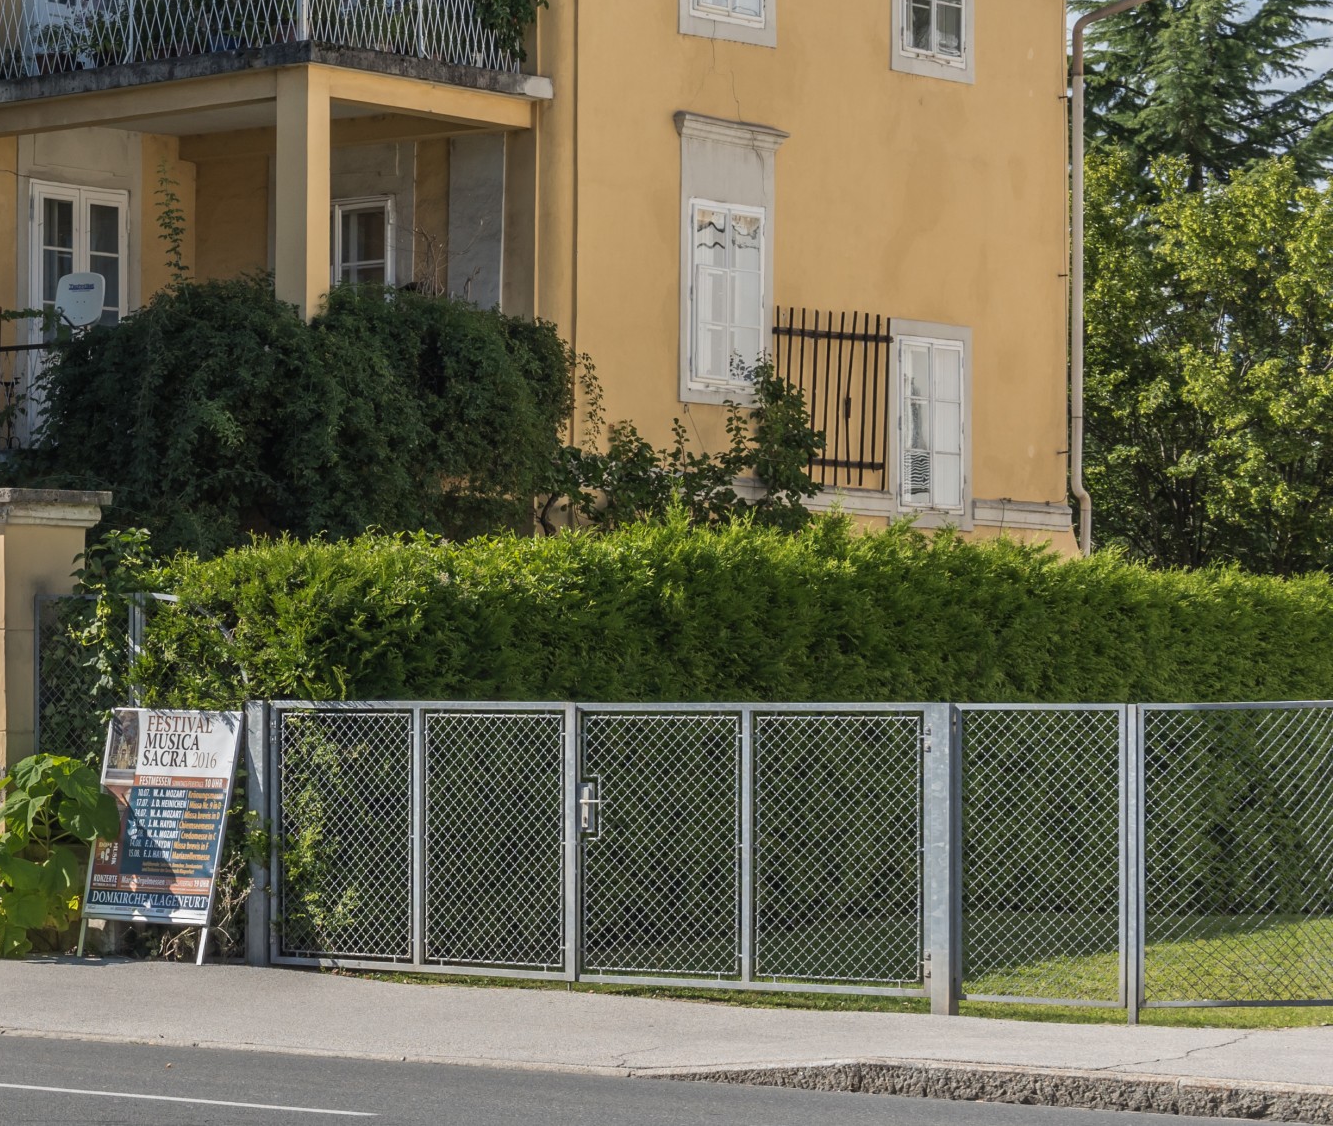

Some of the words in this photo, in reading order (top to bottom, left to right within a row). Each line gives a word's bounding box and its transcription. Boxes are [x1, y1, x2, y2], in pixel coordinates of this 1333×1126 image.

[146, 716, 214, 734] FESTIVAL
[144, 733, 200, 750] MUSICA
[142, 750, 188, 768] SACRA
[191, 752, 217, 768] 2016
[139, 776, 172, 786] FESTMESSEN
[205, 779, 211, 787] 10
[212, 779, 223, 788] UHR
[165, 790, 186, 798] MOZART
[136, 798, 149, 807] 17.07.
[161, 799, 187, 808] HEINICHEN
[162, 810, 182, 818] MOZART
[159, 820, 176, 828] HAYDN
[159, 830, 178, 838] MOZART
[153, 840, 171, 848] HAYDN
[152, 850, 169, 858] HAYDN
[92, 891, 146, 904] DOMKIRCHE
[149, 894, 207, 908] KLAGENFURT
